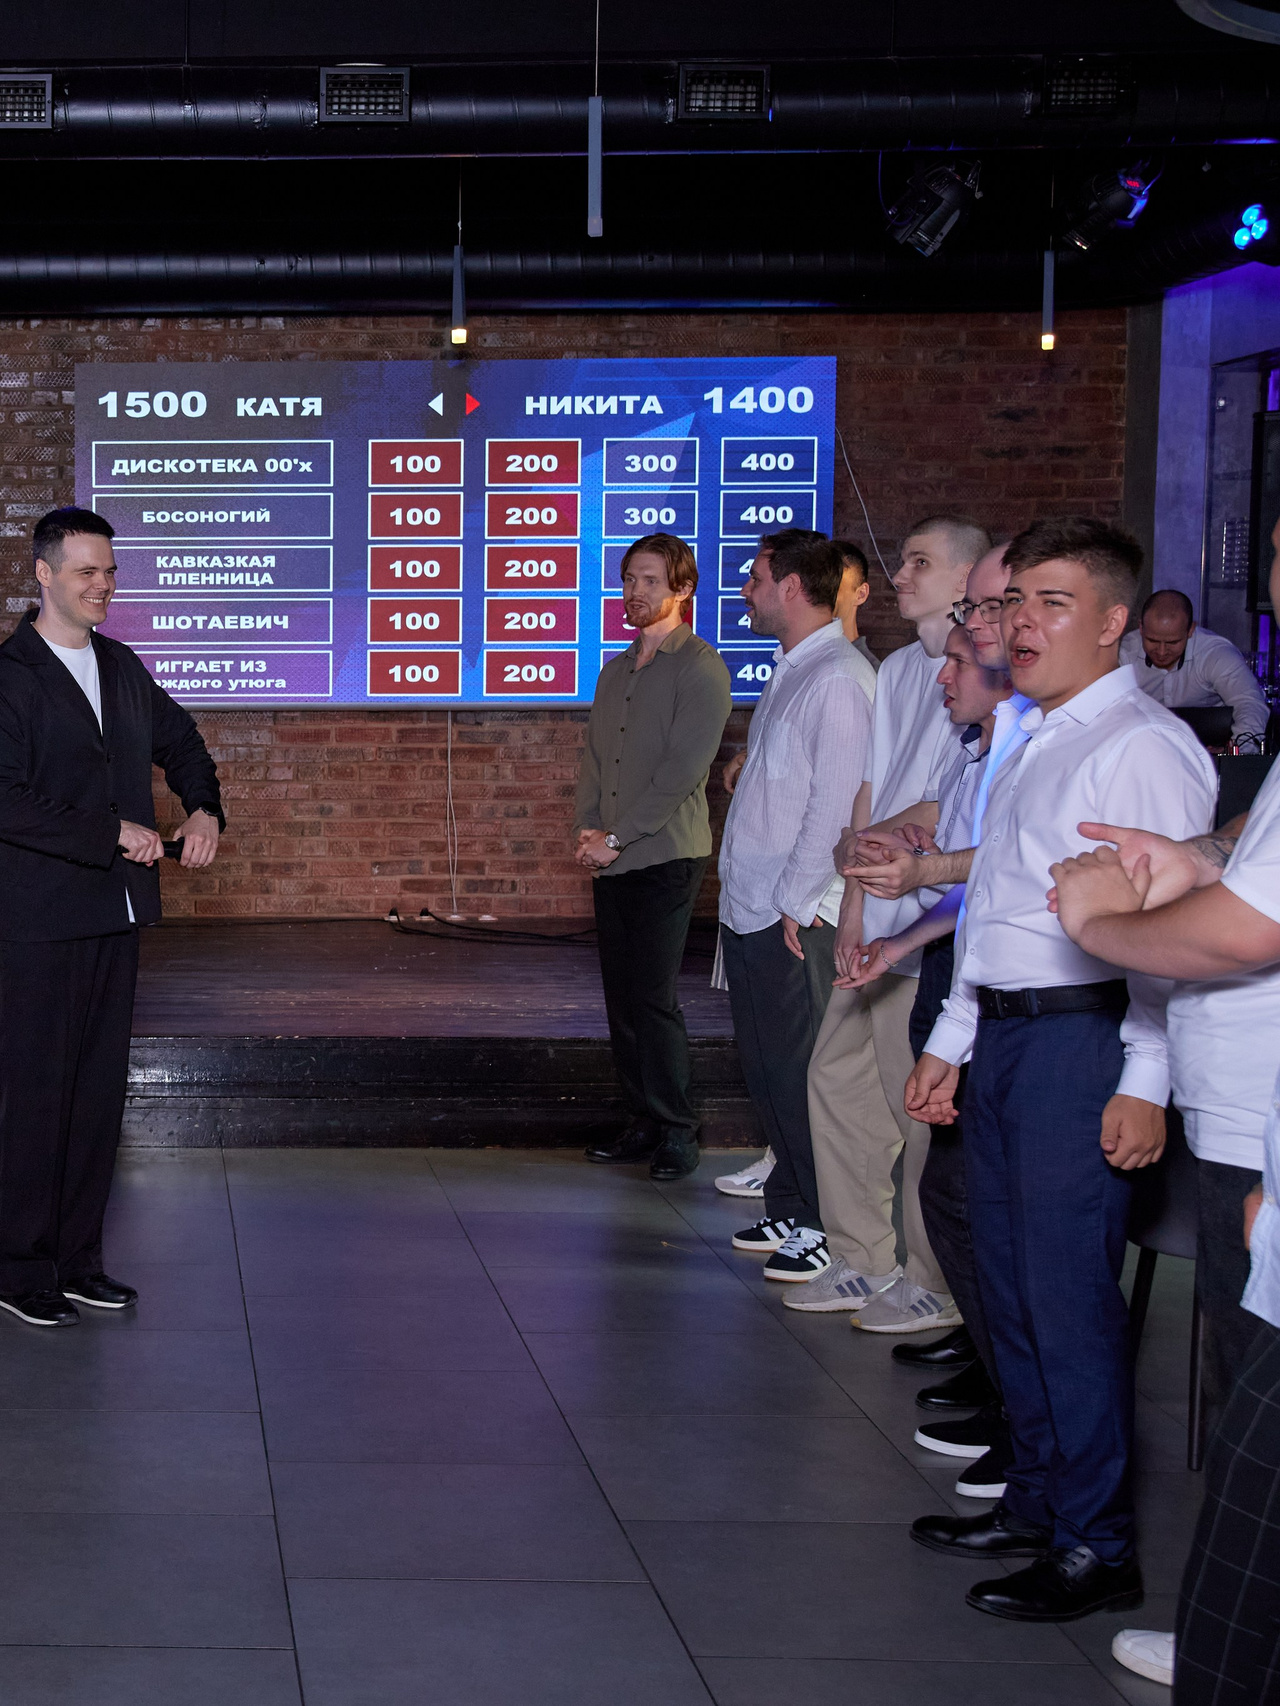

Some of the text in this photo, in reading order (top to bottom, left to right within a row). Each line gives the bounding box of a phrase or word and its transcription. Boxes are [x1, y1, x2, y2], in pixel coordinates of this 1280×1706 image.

[98, 391, 322, 418] 1500 КАТЯ
[525, 386, 814, 415] НИКИТА 1400
[111, 458, 259, 476] ДИСКОТЕКА
[390, 455, 441, 473] 100
[505, 454, 558, 472] 200
[624, 454, 677, 473] 300
[741, 453, 795, 471] 400
[142, 508, 271, 524] БОСОНОГИЙ
[389, 507, 441, 526] 100
[505, 507, 558, 525] 200
[624, 507, 677, 525] 300
[740, 506, 793, 524] 400
[156, 555, 276, 569] КАВКАЗКАЯ
[389, 560, 441, 578] 100
[504, 559, 557, 578] 200
[158, 572, 274, 587] ПЛЕННИЦА
[152, 615, 289, 630] ШОТАЕВИЧ
[388, 612, 440, 630] 100
[503, 612, 556, 630] 200
[155, 660, 267, 673] ИГРАЕТ ИЗ
[388, 664, 440, 683] 100
[503, 664, 556, 683] 200
[737, 664, 773, 682] 40
[153, 678, 287, 692] аждого утюга
